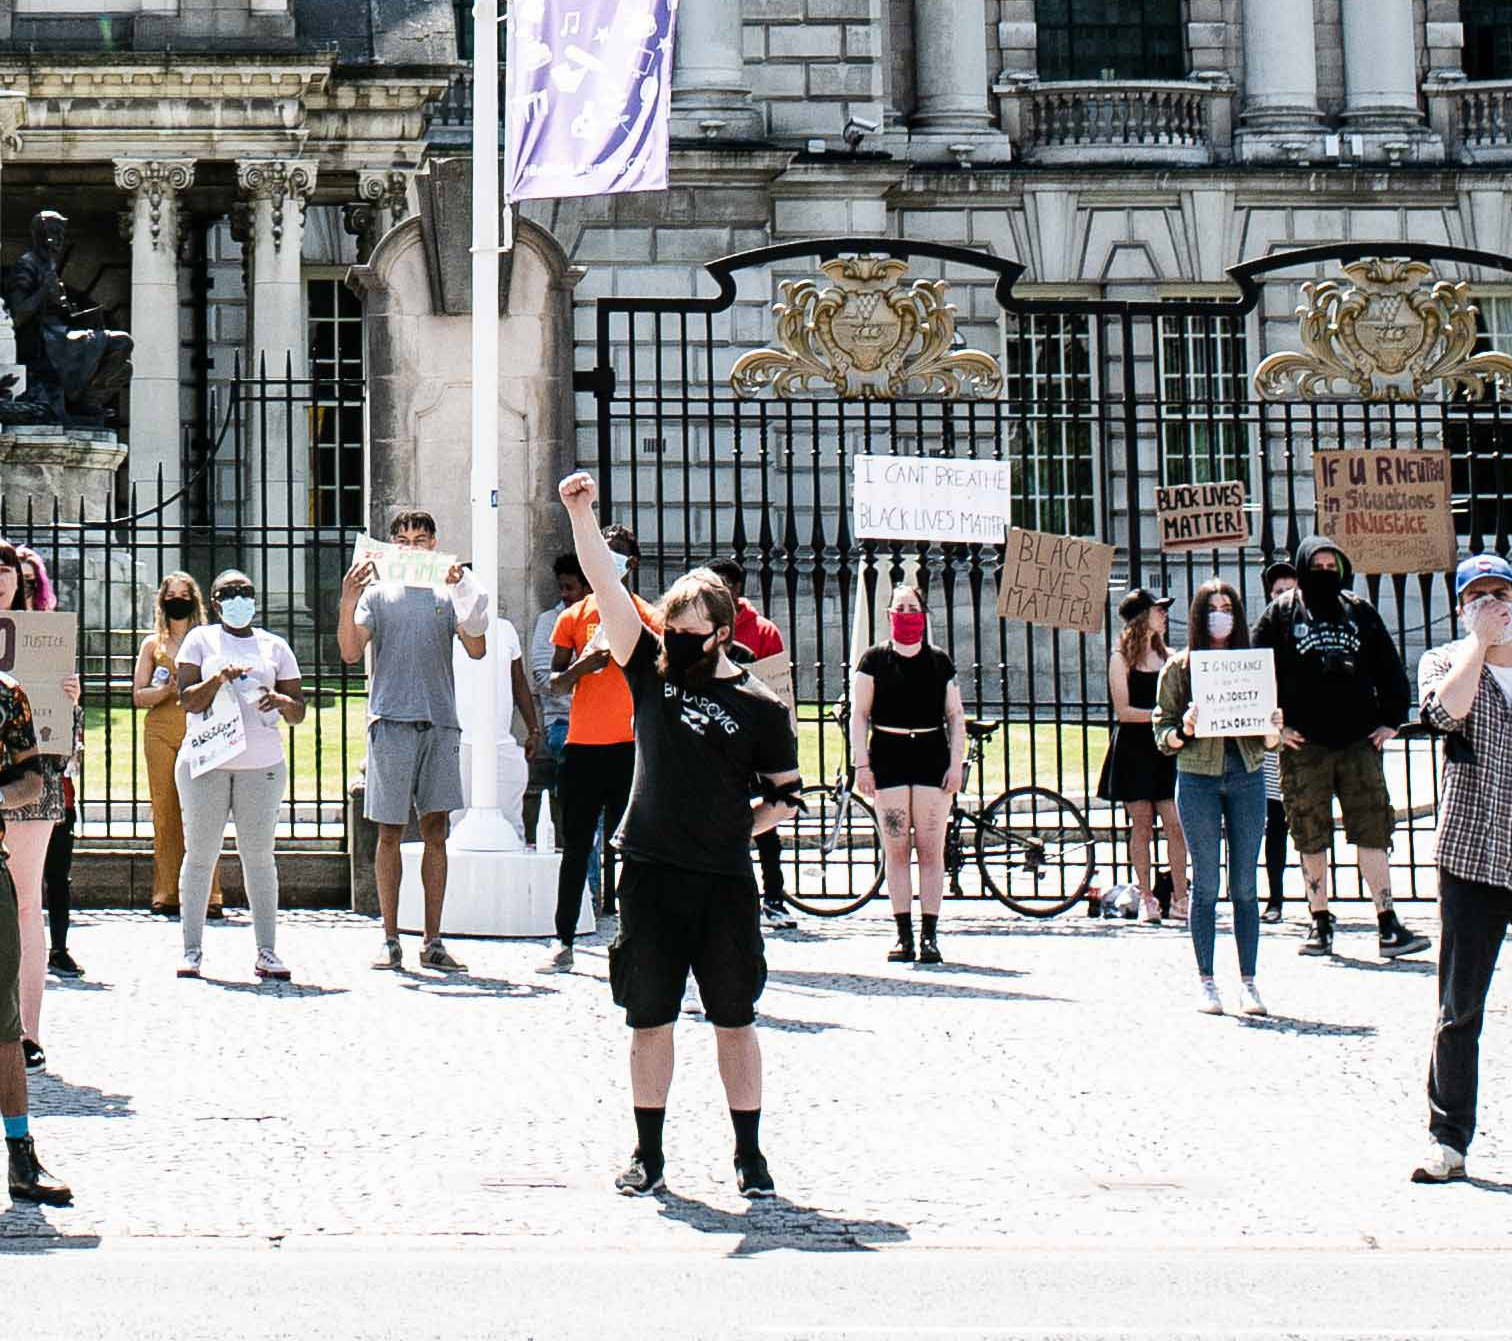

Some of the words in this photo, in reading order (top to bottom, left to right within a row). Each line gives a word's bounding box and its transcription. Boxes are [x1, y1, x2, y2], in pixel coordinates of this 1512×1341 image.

[863, 458, 875, 485] I
[934, 465, 1009, 491] BREATHE
[1321, 456, 1341, 488] IF
[1348, 457, 1368, 486] U
[1375, 455, 1394, 486] R
[1202, 483, 1243, 507] LIVES
[858, 501, 910, 532] BLACK
[913, 507, 957, 533] LIVES
[1163, 509, 1243, 541] MATTER!
[1018, 531, 1094, 573] BLACK
[1014, 563, 1092, 602] LIVES
[1005, 586, 1094, 627] MATTER
